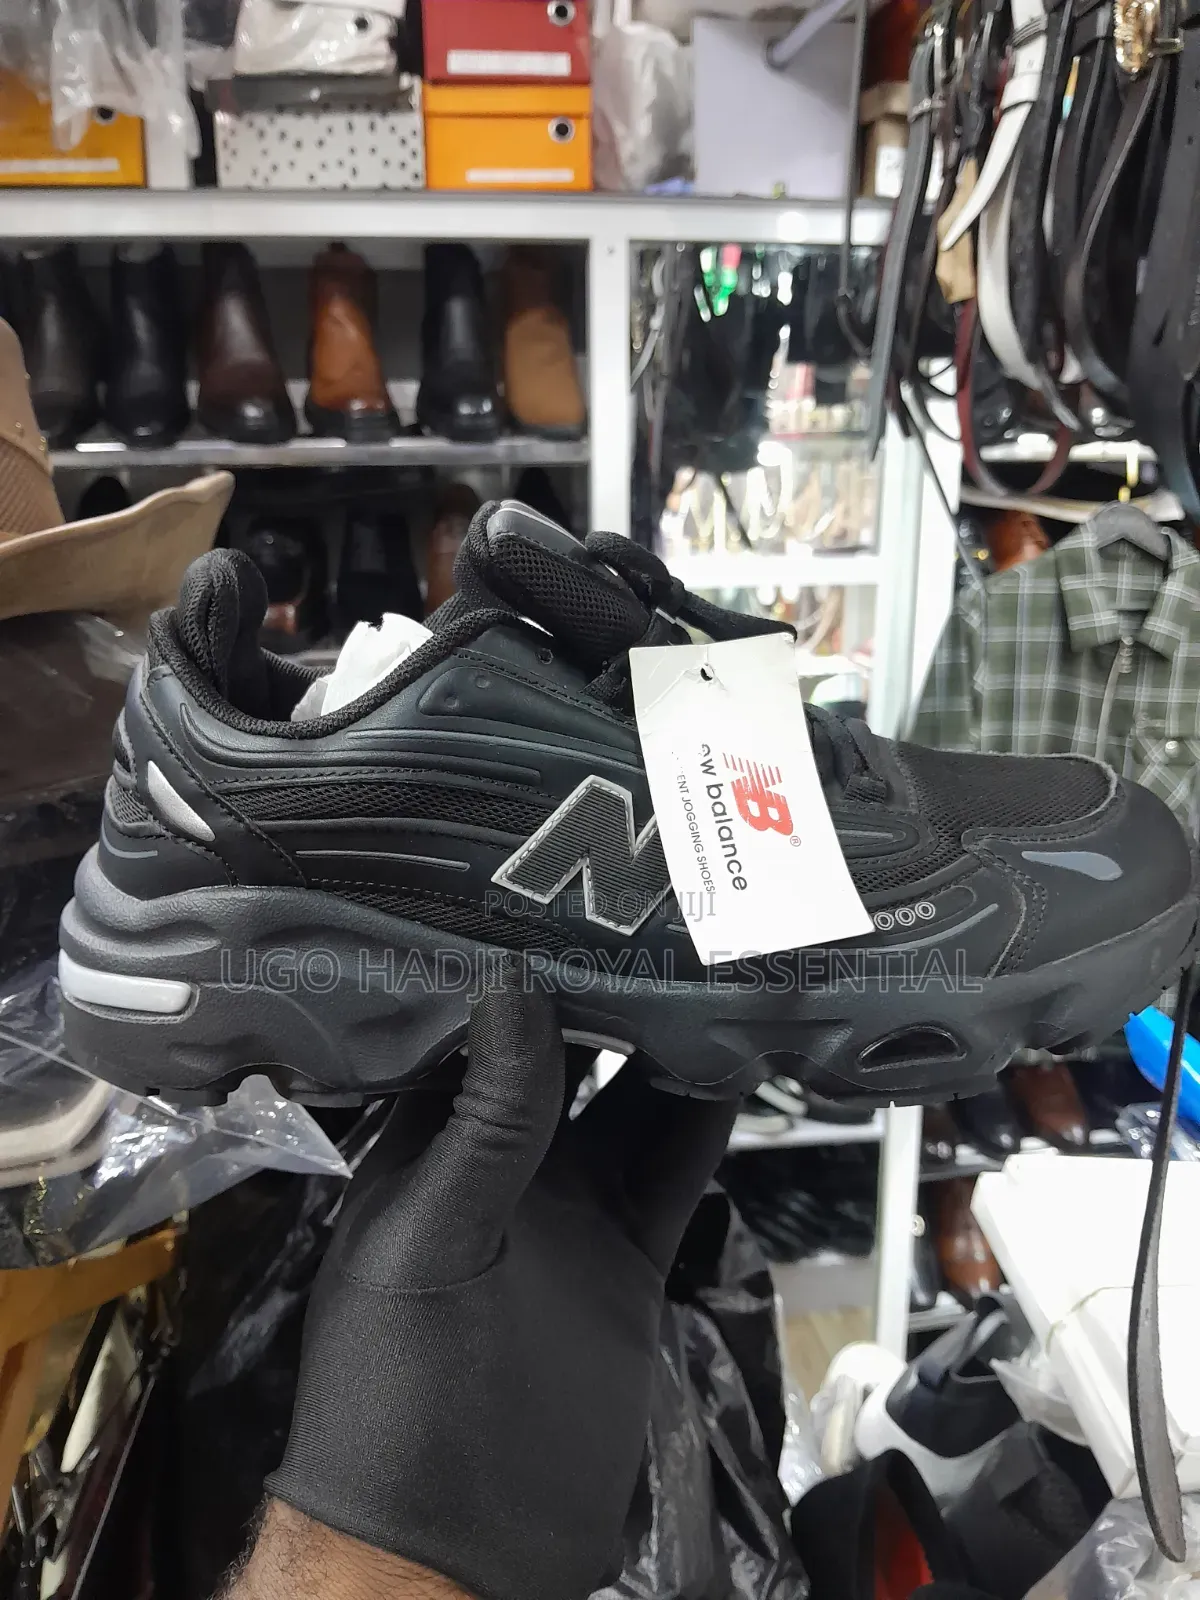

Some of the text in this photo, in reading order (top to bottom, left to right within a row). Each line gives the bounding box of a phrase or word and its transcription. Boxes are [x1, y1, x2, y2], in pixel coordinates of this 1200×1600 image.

[681, 797, 704, 853] JOGGING
[697, 856, 716, 892] SHOES
[706, 783, 748, 891] balance
